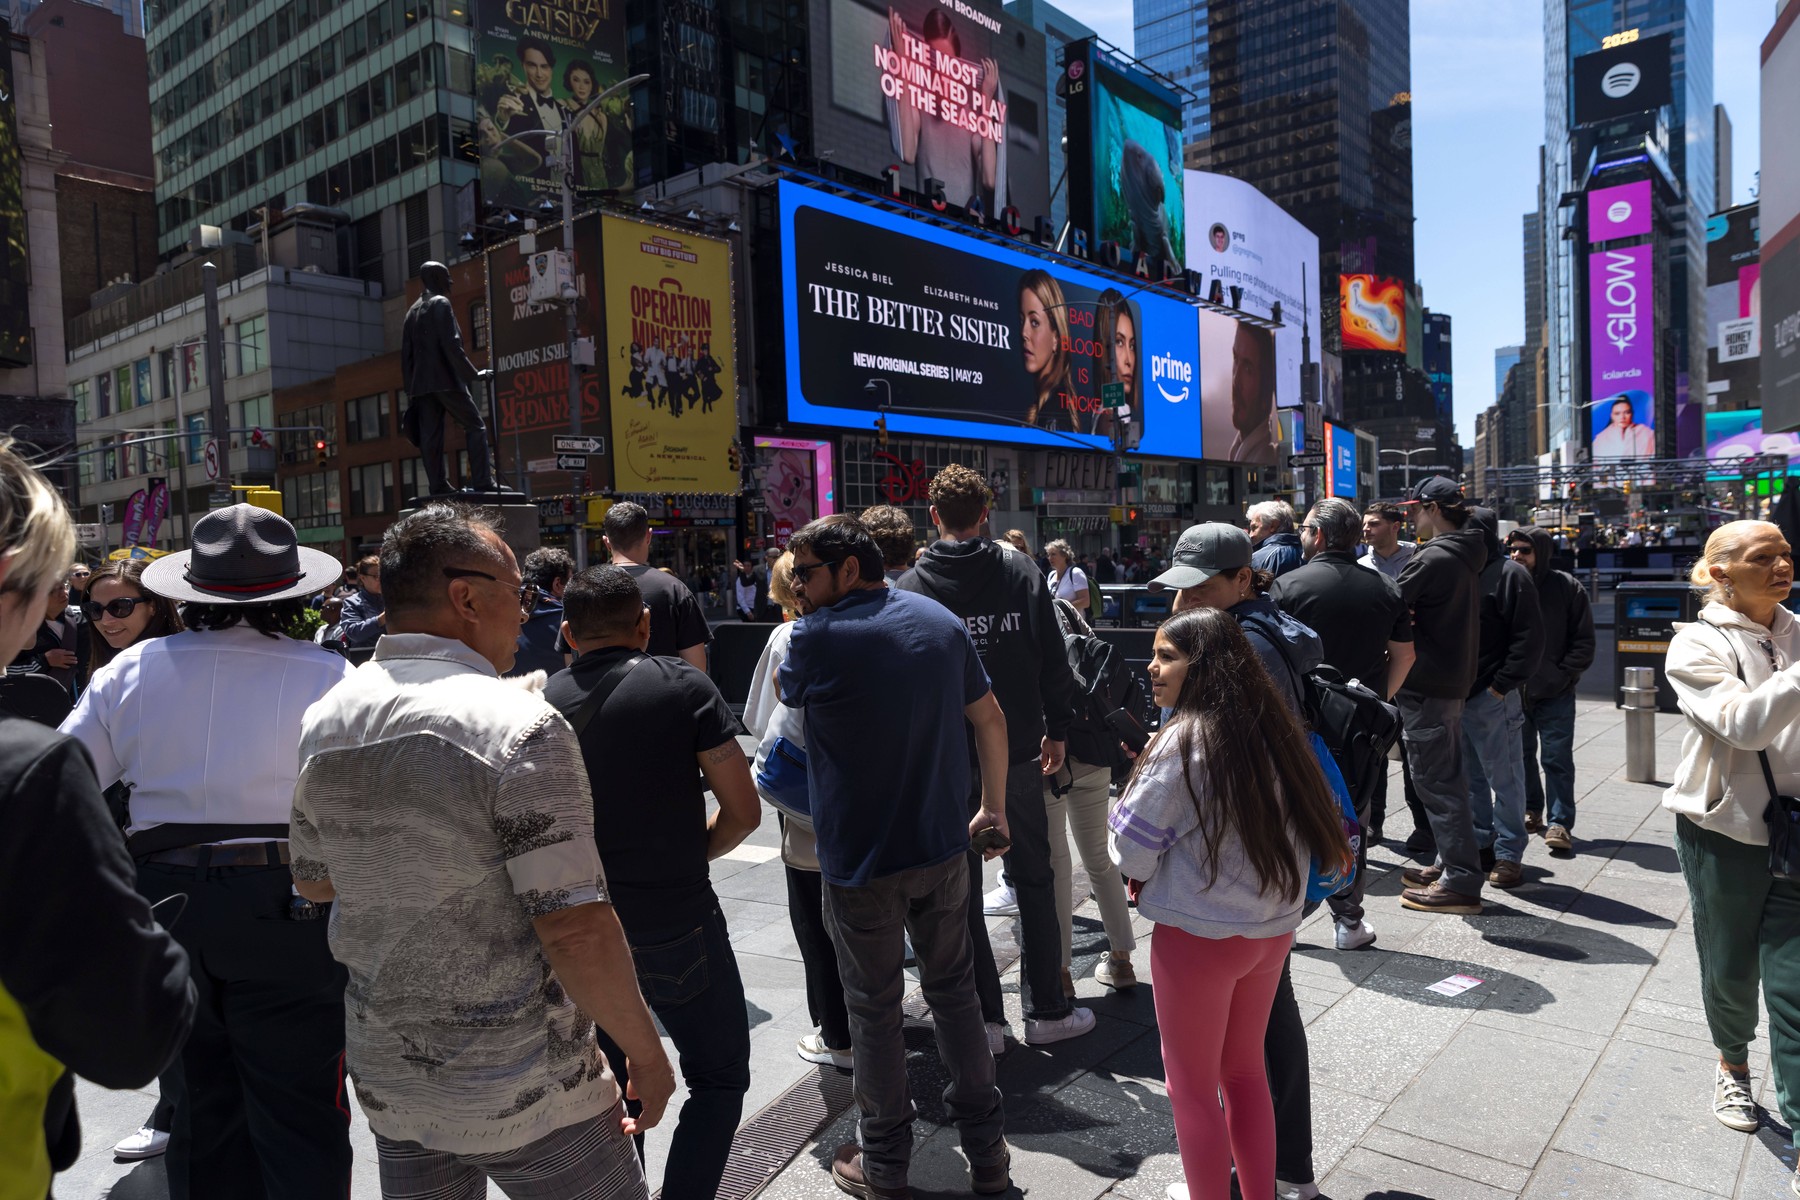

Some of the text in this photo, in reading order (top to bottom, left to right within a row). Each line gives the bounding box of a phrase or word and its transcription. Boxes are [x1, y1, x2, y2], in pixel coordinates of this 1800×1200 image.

[505, 0, 599, 41] GATSBY
[955, 0, 1002, 34] BROADWAY
[522, 28, 586, 49] A NEW MUSICAL
[1602, 28, 1639, 50] 2025
[901, 32, 978, 88] THE MOST
[874, 43, 1007, 125] NOMINATED PLAY
[1069, 80, 1084, 95] LG
[881, 74, 1004, 144] OF THE SEASON!
[1232, 230, 1246, 243] greg
[642, 244, 697, 263] VERY BIG FUTURE
[505, 266, 530, 286] OWN
[825, 261, 894, 286] JESSICA BIEL
[1210, 264, 1242, 283] Pulling
[630, 285, 712, 329] OPERATION
[924, 285, 999, 311] ELIZABETH BANKS
[1606, 251, 1637, 342] GLOW
[808, 283, 1011, 351] THE BETTER SISTER
[1069, 307, 1094, 328] BAD
[1061, 335, 1104, 359] BLOOD
[497, 347, 540, 373] SHADOW
[853, 351, 983, 385] NEW ORIGINAL SERIES MAY 29
[1152, 351, 1192, 384] prime
[513, 364, 570, 398] HINGS
[1078, 366, 1089, 384] IS
[1602, 367, 1642, 381] iolanda
[499, 380, 601, 431] SRANGER
[873, 450, 931, 505] Dis
[1045, 451, 1112, 489] FOREVE
[675, 495, 736, 510] LUGGAGE
[1148, 504, 1162, 513] POLO
[777, 527, 792, 536] MINI
[1067, 516, 1099, 531] FOREVER
